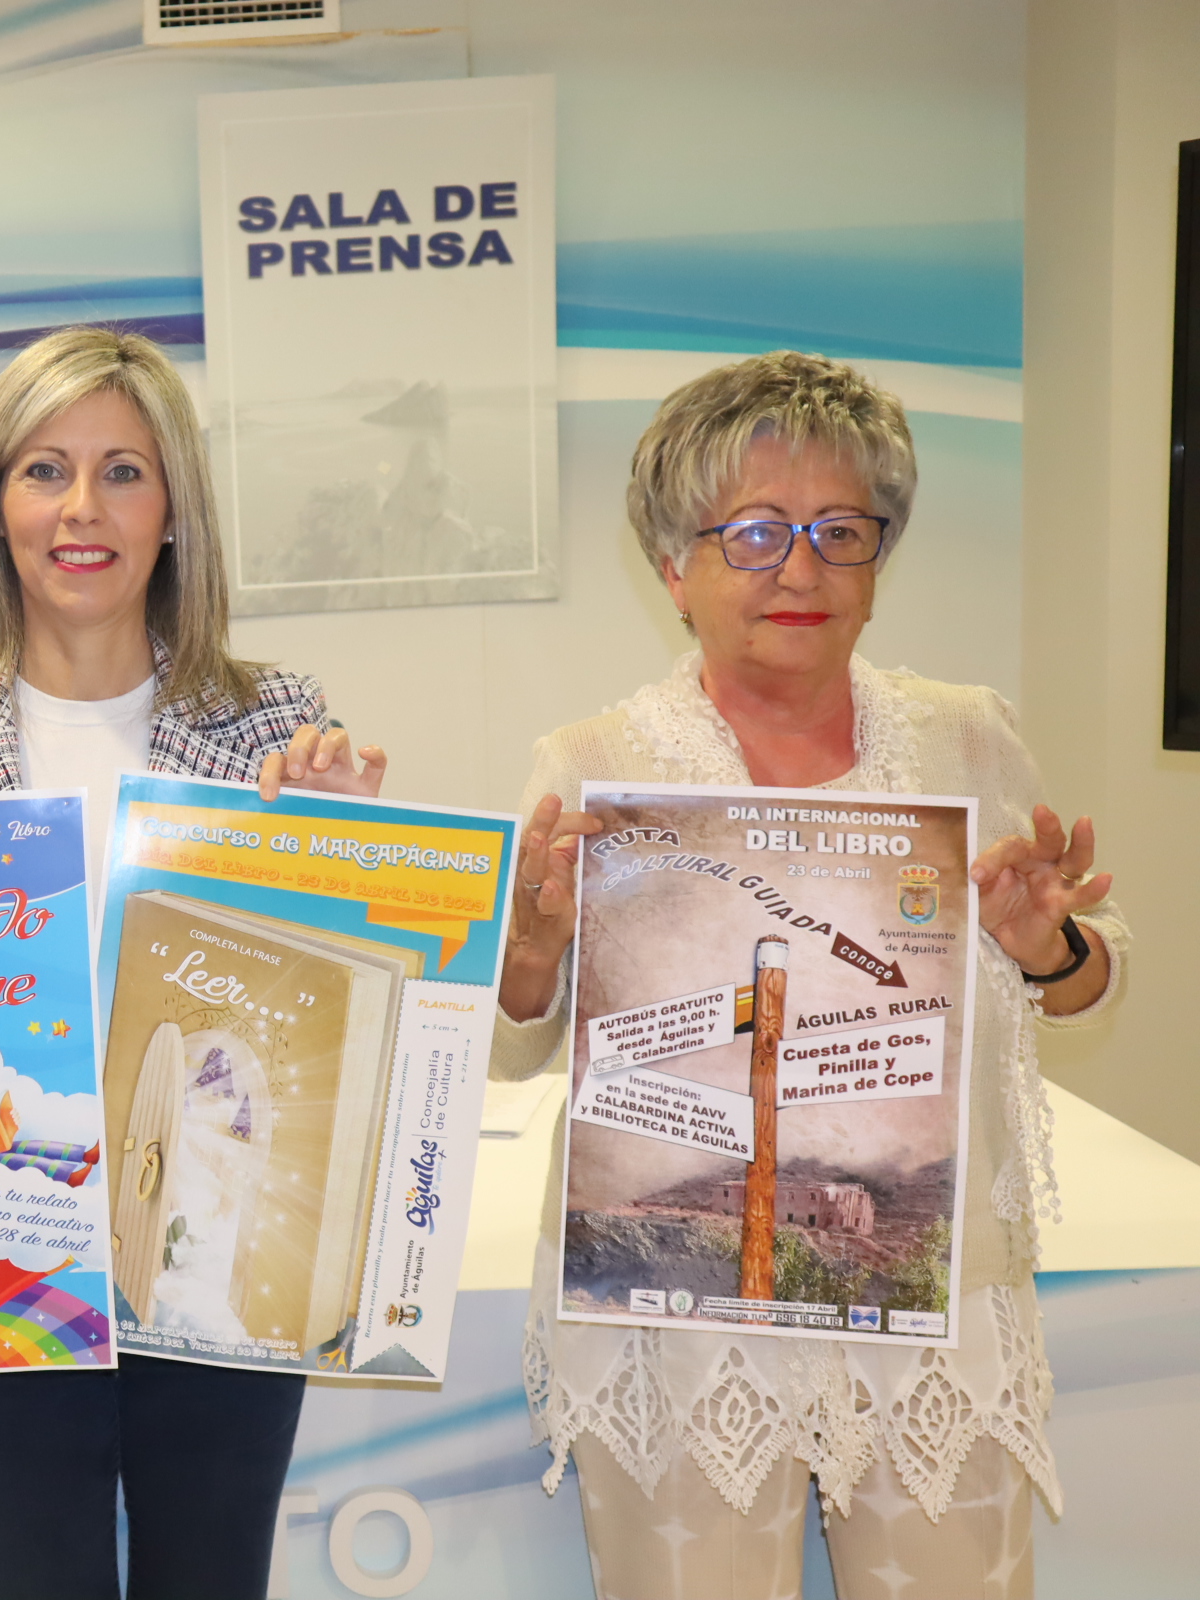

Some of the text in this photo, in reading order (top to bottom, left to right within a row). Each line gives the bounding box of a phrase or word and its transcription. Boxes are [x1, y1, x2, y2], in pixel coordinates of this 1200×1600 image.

[238, 181, 518, 233] SALA DE
[247, 229, 514, 280] PRENSA
[7, 820, 52, 841] Libro
[727, 806, 922, 828] DIA INTERNACIONAL
[139, 816, 491, 875] Concurso de MARCAPÁGINAS
[591, 827, 681, 859] RUTA
[746, 828, 913, 857] DEL LIBRO
[786, 863, 871, 879] 23 de Abril
[602, 853, 833, 936] CULTURAL GUIADA
[189, 929, 283, 966] COMPLETA LA FRASE
[878, 928, 957, 940] Ayuntamiento
[885, 940, 948, 955] de Águilas
[839, 945, 894, 980] conoce
[417, 999, 476, 1012] PLANTILLA
[597, 993, 724, 1032] AUTOBÚS GRATUITO
[796, 996, 953, 1030] ÁGUILAS RURAL
[606, 1007, 721, 1042] Salida a las 9,00 h.
[616, 1022, 716, 1052] desde Águilas y
[631, 1037, 705, 1061] Calabardina
[783, 1033, 931, 1062] Cuesta de Gos,
[818, 1057, 896, 1076] Pinilla y
[420, 1049, 440, 1129] Concejalía
[434, 1052, 454, 1130] de Cultura
[628, 1074, 702, 1101] Inscripción:
[782, 1071, 934, 1101] Marina de Cope
[594, 1093, 736, 1138] CALABARDINA ACTIVA
[606, 1084, 727, 1120] en la sede de AAVV
[580, 1105, 749, 1154] y BIBLIOTECA DE ÁGUILAS
[5, 1189, 24, 1202] tu
[26, 1193, 79, 1210] relato
[16, 1211, 95, 1233] educativo
[20, 1232, 42, 1246] de
[45, 1235, 92, 1253] abril
[400, 1239, 415, 1299] Ayuntamiento
[412, 1246, 426, 1294] de Águilas
[775, 1313, 797, 1323] 696
[799, 1315, 810, 1324] 18
[812, 1316, 827, 1325] 40
[829, 1317, 841, 1326] 18
